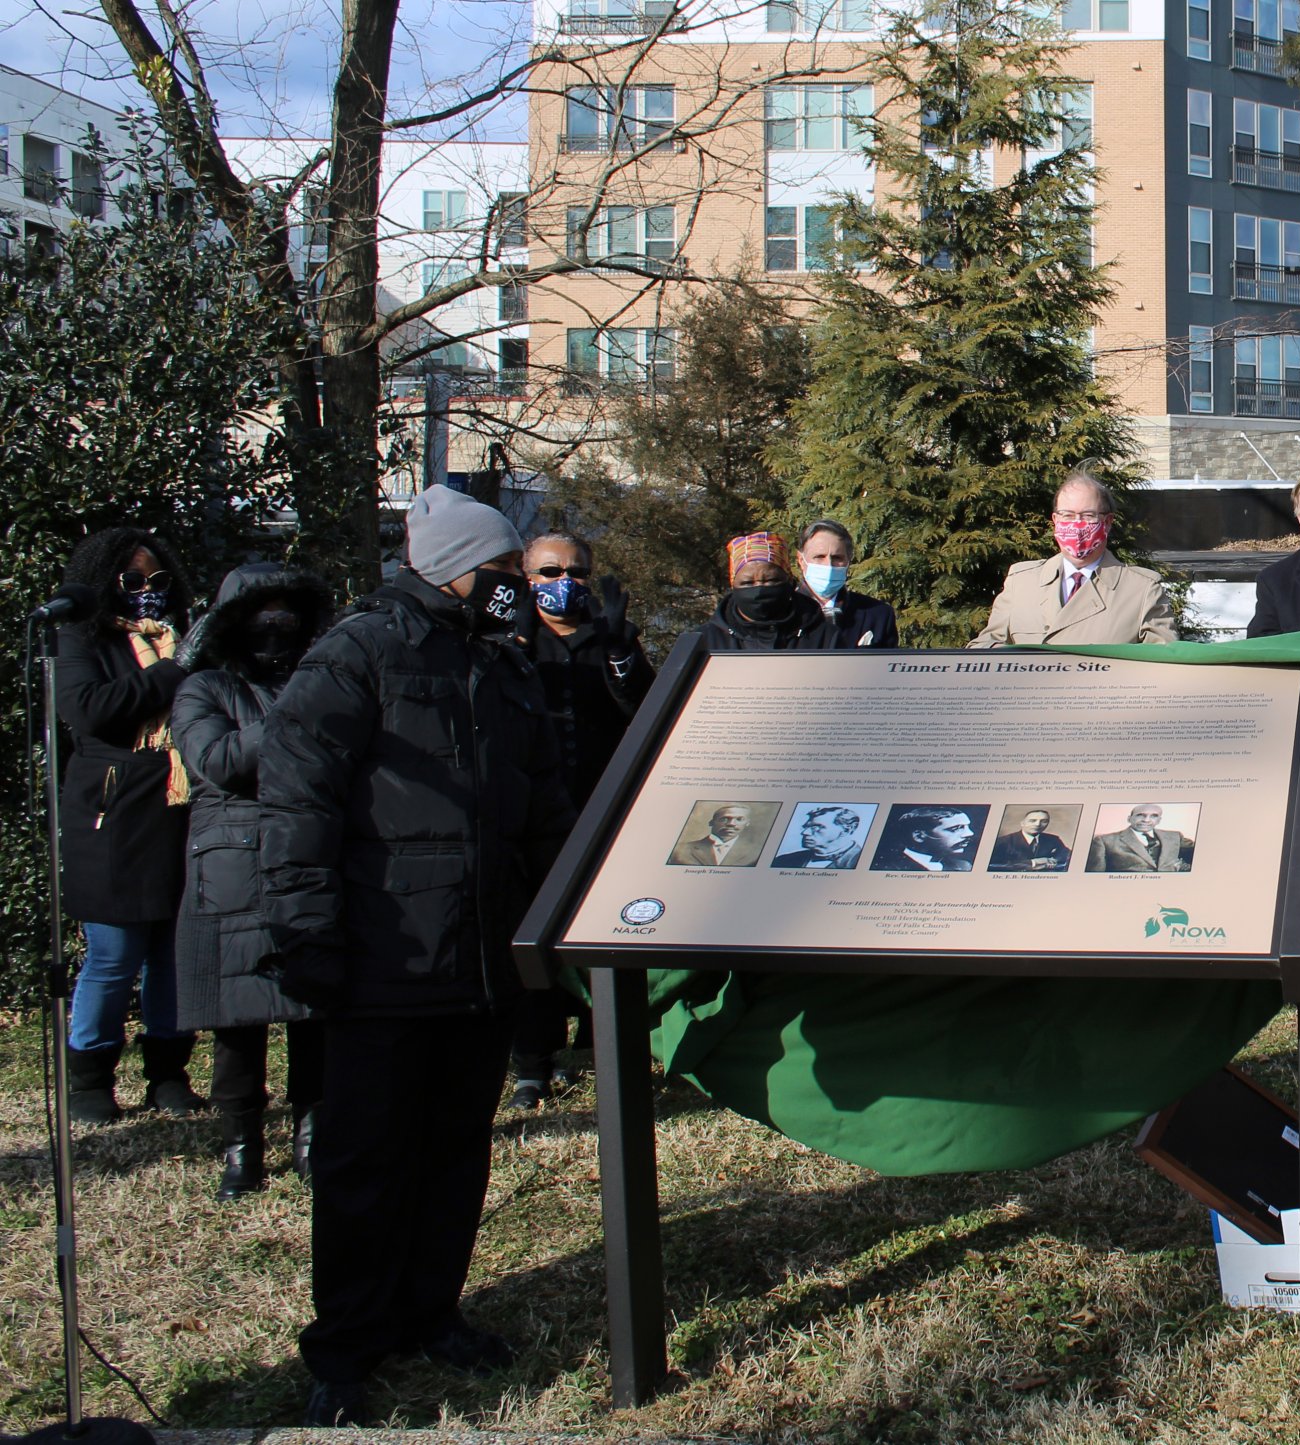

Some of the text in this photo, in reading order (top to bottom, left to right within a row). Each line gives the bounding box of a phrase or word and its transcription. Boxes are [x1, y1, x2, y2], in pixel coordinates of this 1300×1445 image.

[492, 585, 515, 604] 50
[888, 661, 1111, 673] Tinner Hill Historic Site
[1171, 927, 1226, 938] NOVA
